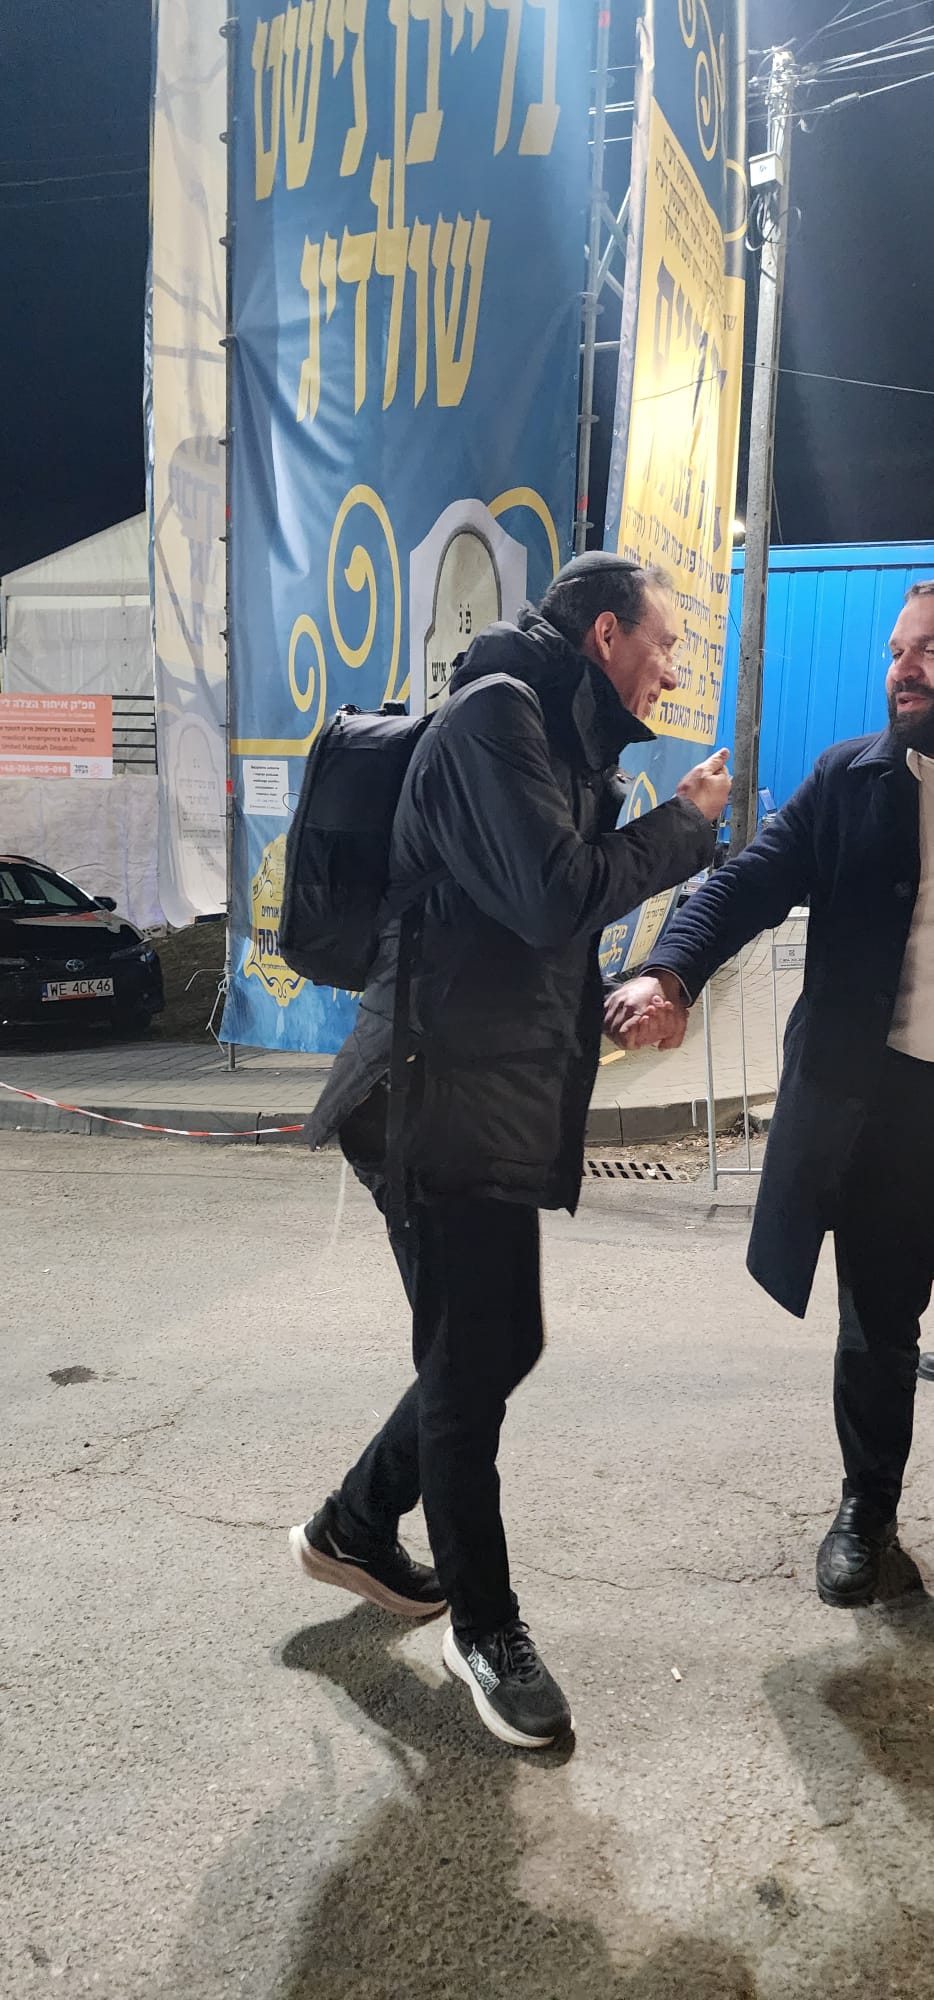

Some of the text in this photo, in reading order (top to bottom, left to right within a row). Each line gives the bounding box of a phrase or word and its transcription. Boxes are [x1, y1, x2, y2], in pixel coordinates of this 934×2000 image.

[297, 154, 490, 422] שולדיג
[50, 979, 111, 997] WE 4CK46
